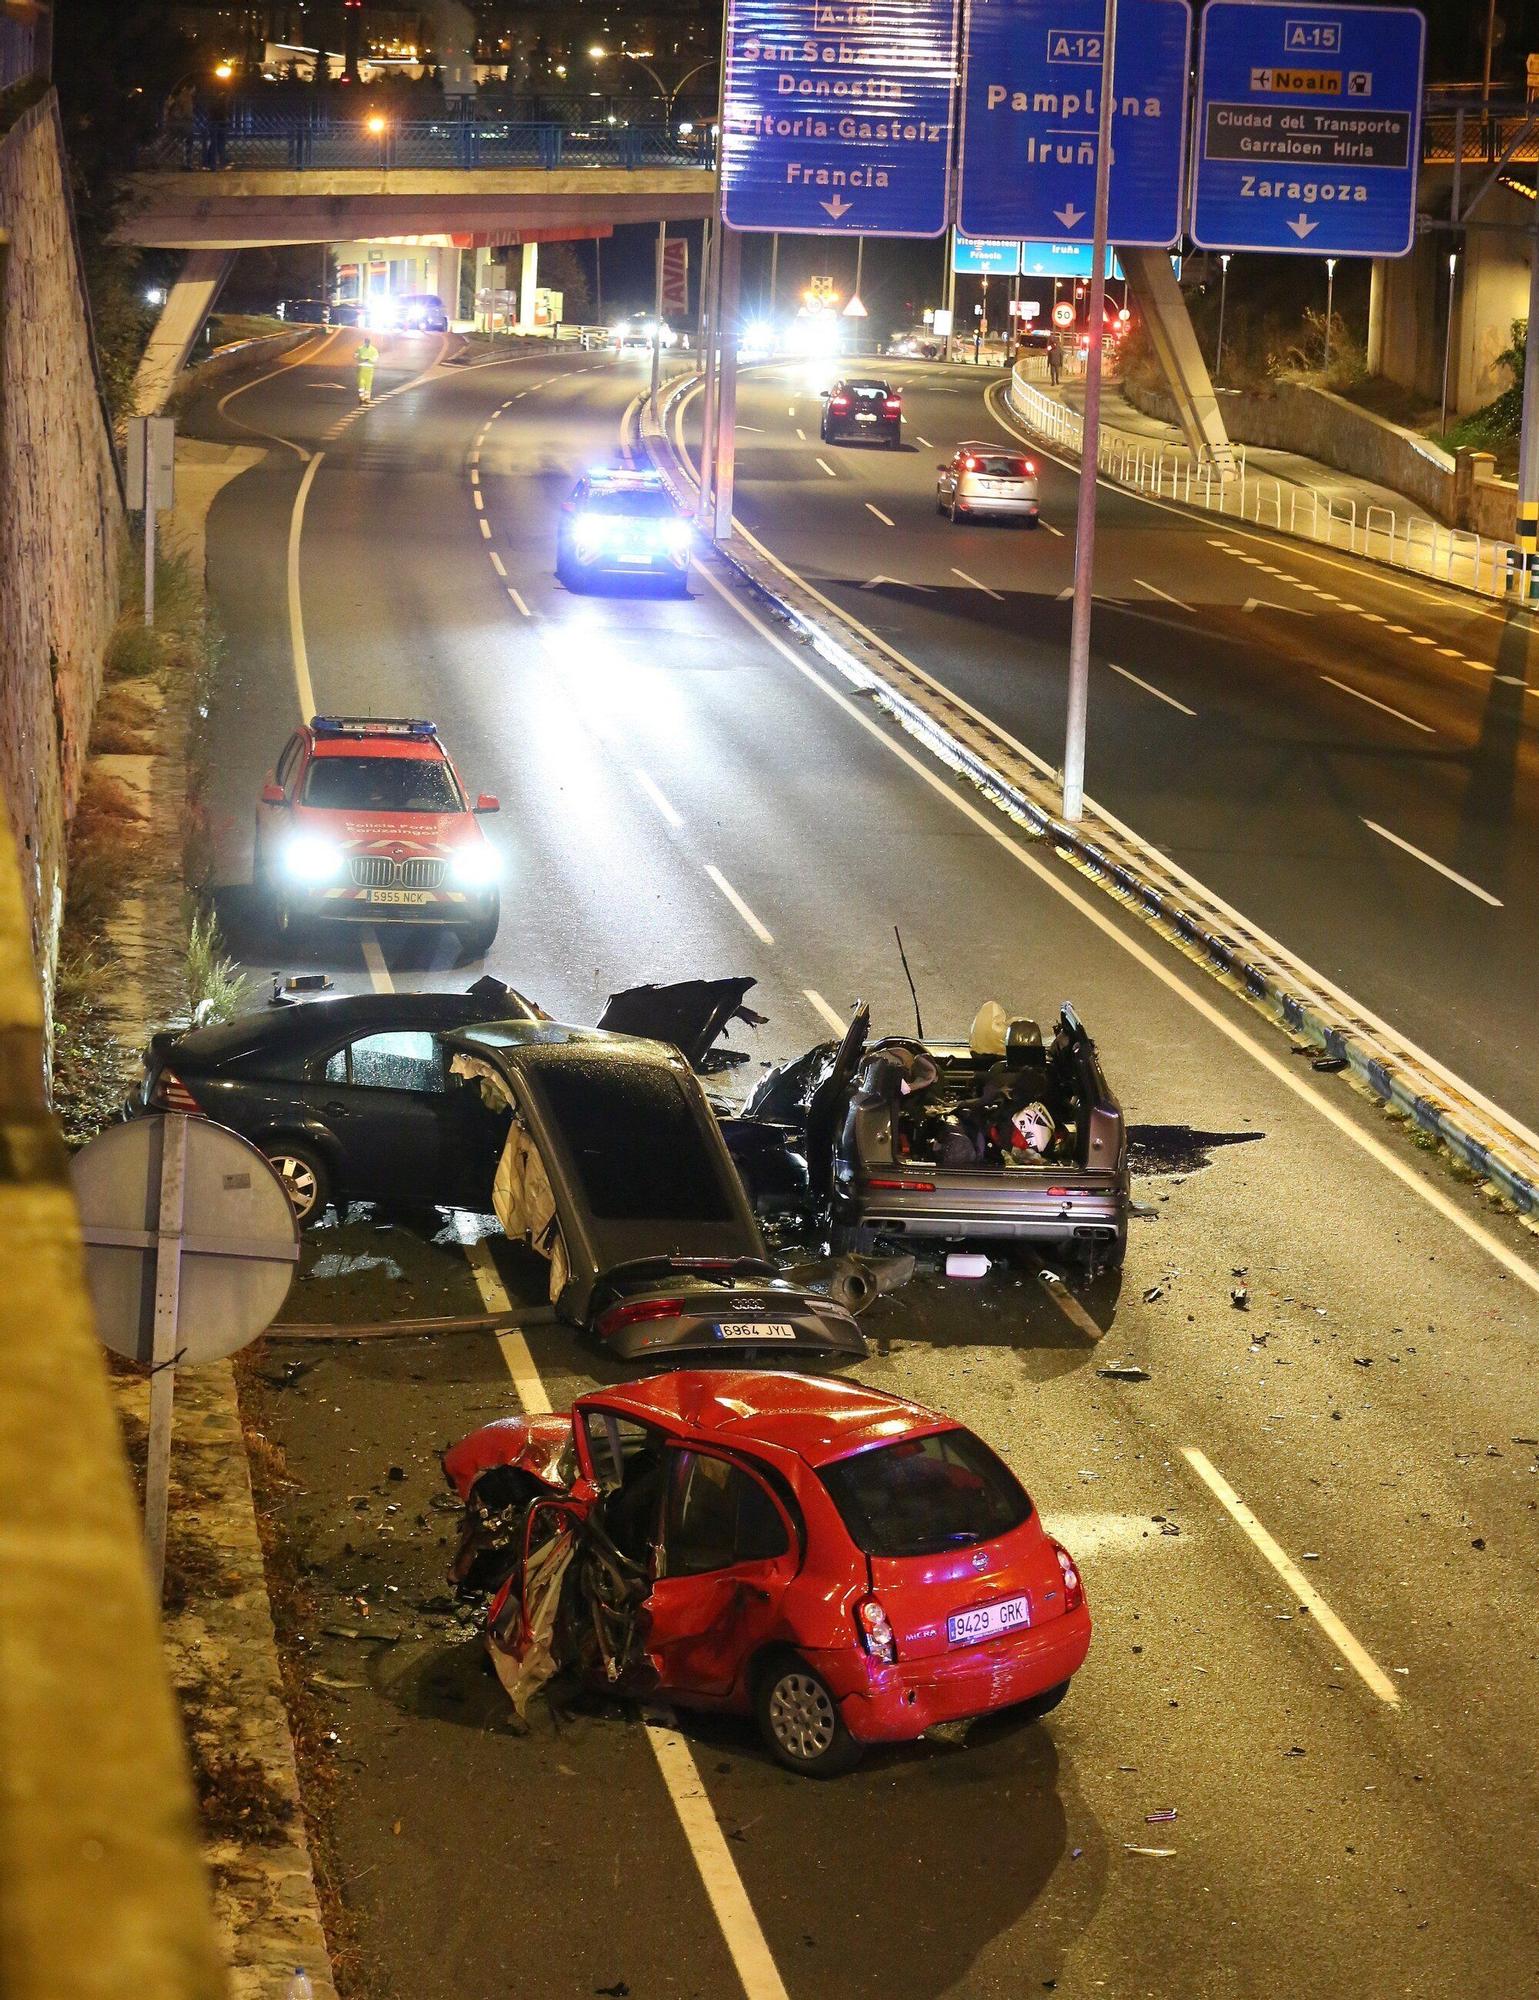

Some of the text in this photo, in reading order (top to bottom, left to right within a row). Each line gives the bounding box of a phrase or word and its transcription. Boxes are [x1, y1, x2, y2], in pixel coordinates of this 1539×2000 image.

[1053, 36, 1100, 58] A-12
[1291, 27, 1336, 48] A-15
[743, 38, 794, 62] San
[1216, 111, 1401, 135] Ciudad del Transporte
[1027, 137, 1115, 166] Iruñ
[1333, 141, 1374, 158] Hiria
[786, 163, 889, 188] Francia
[1240, 175, 1368, 204] Zaragoza
[373, 892, 424, 903] 5955 NCK
[723, 1324, 792, 1337] 6964 JYL
[957, 1611, 990, 1636] 9429
[1000, 1602, 1023, 1624] GRK
